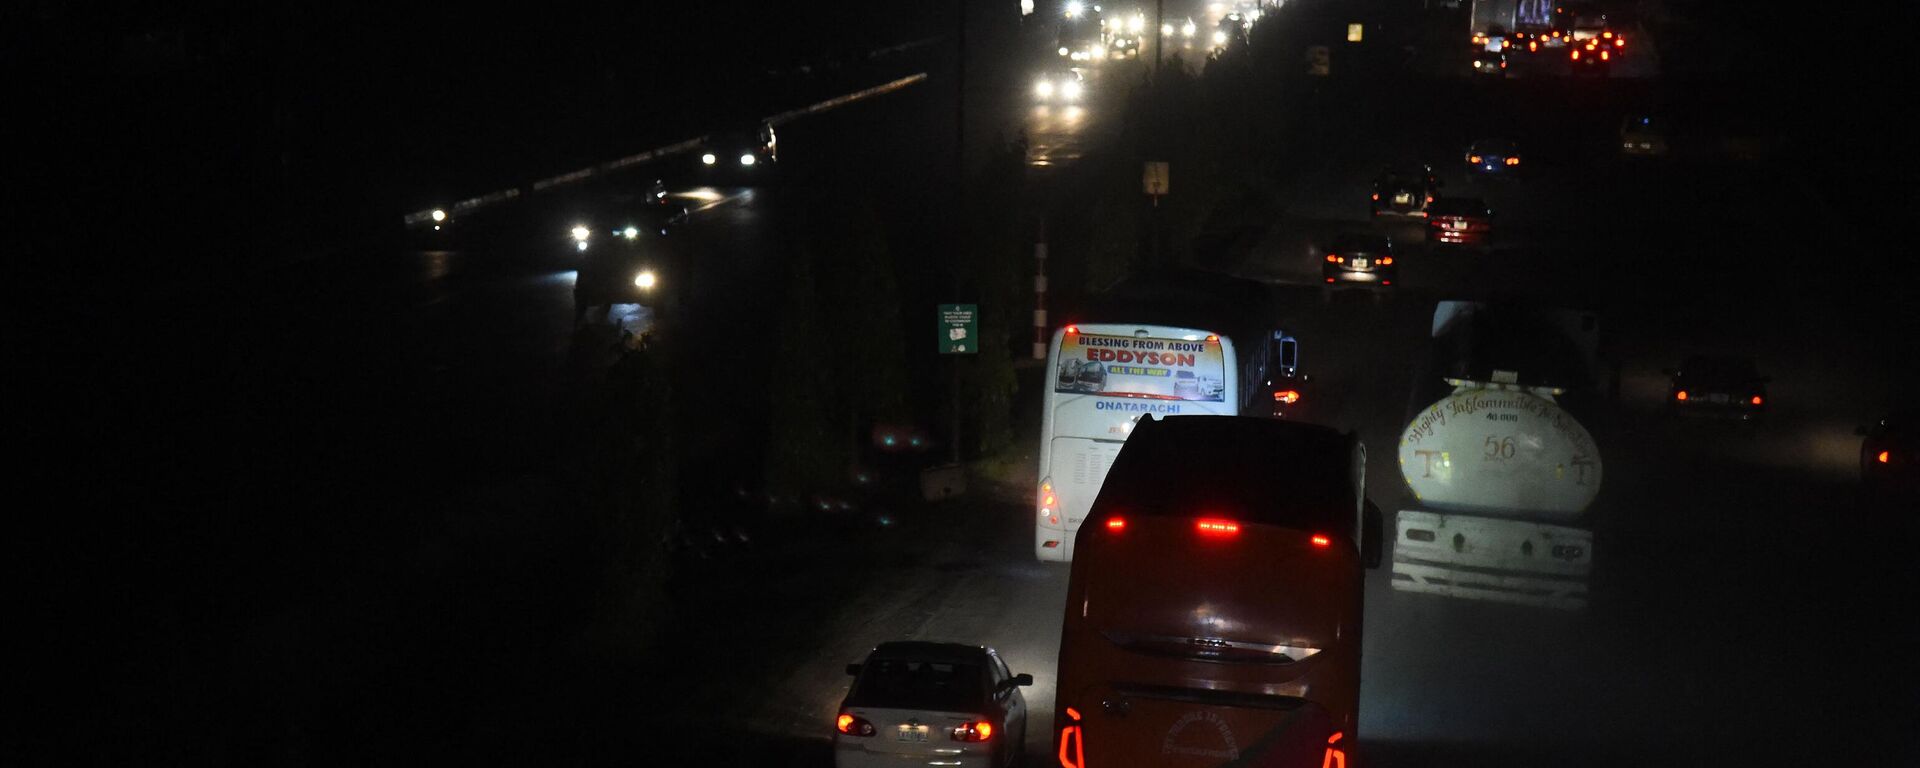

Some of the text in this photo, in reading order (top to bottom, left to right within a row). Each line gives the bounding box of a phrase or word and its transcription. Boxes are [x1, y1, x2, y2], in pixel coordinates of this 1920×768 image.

[1079, 336, 1204, 352] BLESSING FROM ABOVE
[1086, 348, 1195, 367] EDDYSON
[1110, 367, 1169, 377] ALL THE WAY
[1096, 401, 1180, 413] ONATARACHI
[1408, 408, 1446, 443] Highly
[1484, 435, 1516, 459] 56
